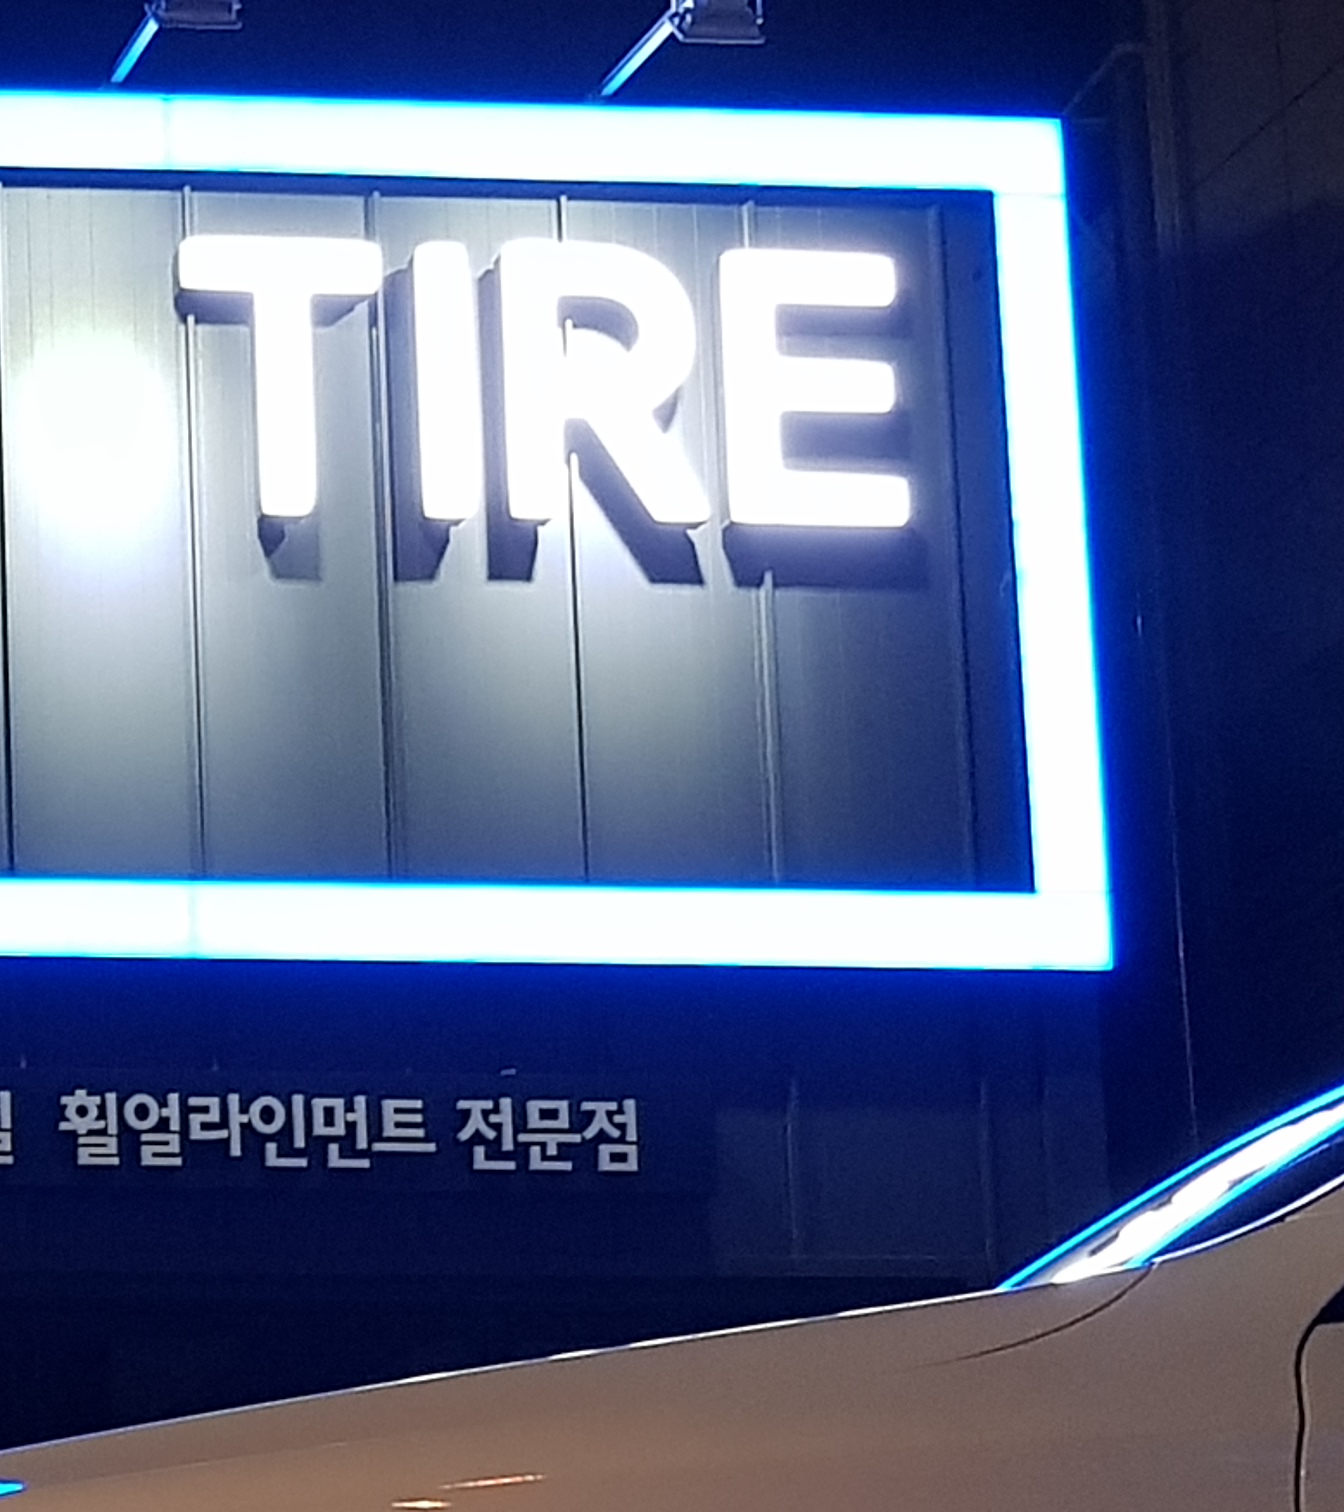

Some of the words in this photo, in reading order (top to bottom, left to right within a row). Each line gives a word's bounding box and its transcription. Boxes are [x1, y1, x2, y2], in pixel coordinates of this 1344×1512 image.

[178, 233, 912, 530] TIRE
[58, 1089, 437, 1169] 휠얼라인먼트
[456, 1097, 638, 1172] 전문점
